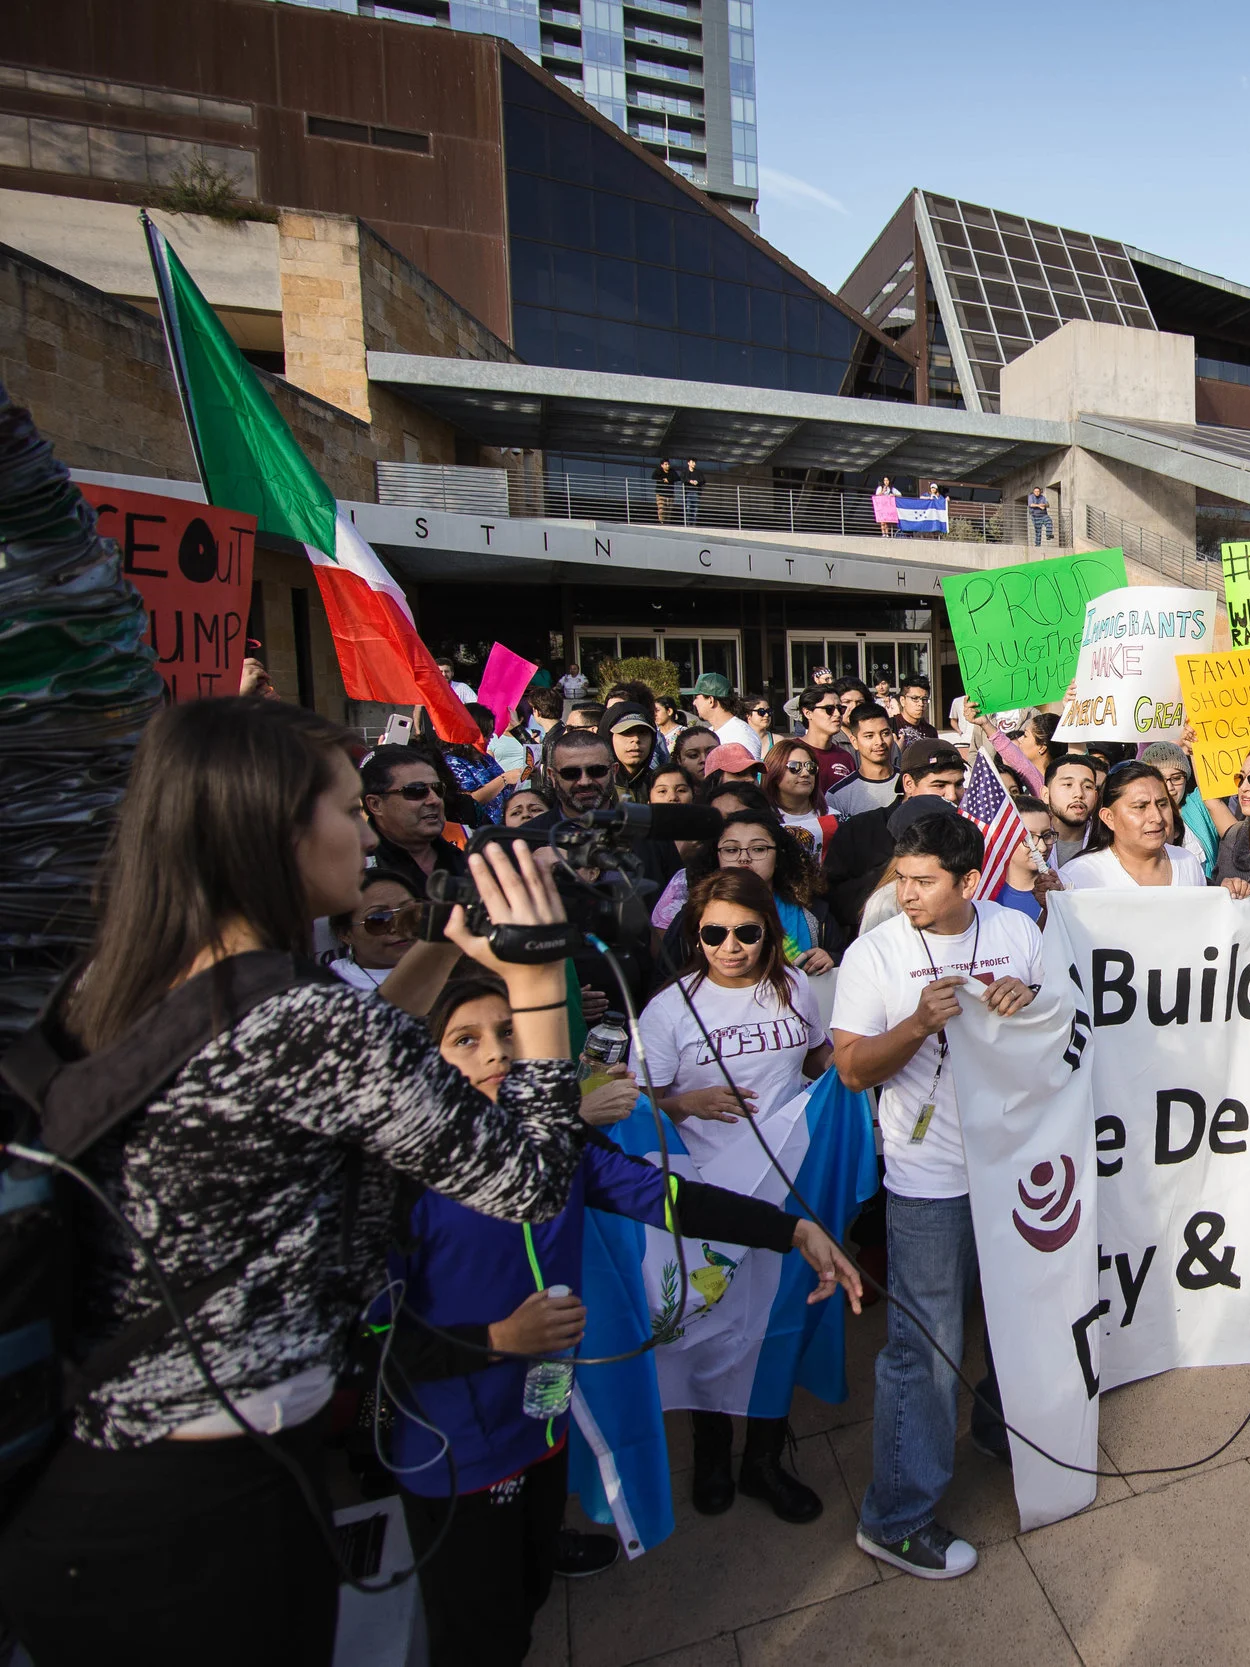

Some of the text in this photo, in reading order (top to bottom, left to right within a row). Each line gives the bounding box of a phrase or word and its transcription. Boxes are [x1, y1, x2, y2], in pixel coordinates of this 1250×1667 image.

[351, 510, 942, 591] STIN CITY HA
[151, 610, 241, 669] UMP
[1082, 608, 1207, 647] IMMIGRANTS
[1090, 643, 1144, 680] MAKE
[1061, 696, 1184, 733] AMERICA GREA
[1201, 745, 1248, 786] NOT
[910, 966, 943, 978] WORKERS
[980, 956, 1010, 968] PROJECT
[696, 1014, 807, 1066] AUSTIN
[1095, 1115, 1126, 1177] e
[1176, 1211, 1241, 1290] &
